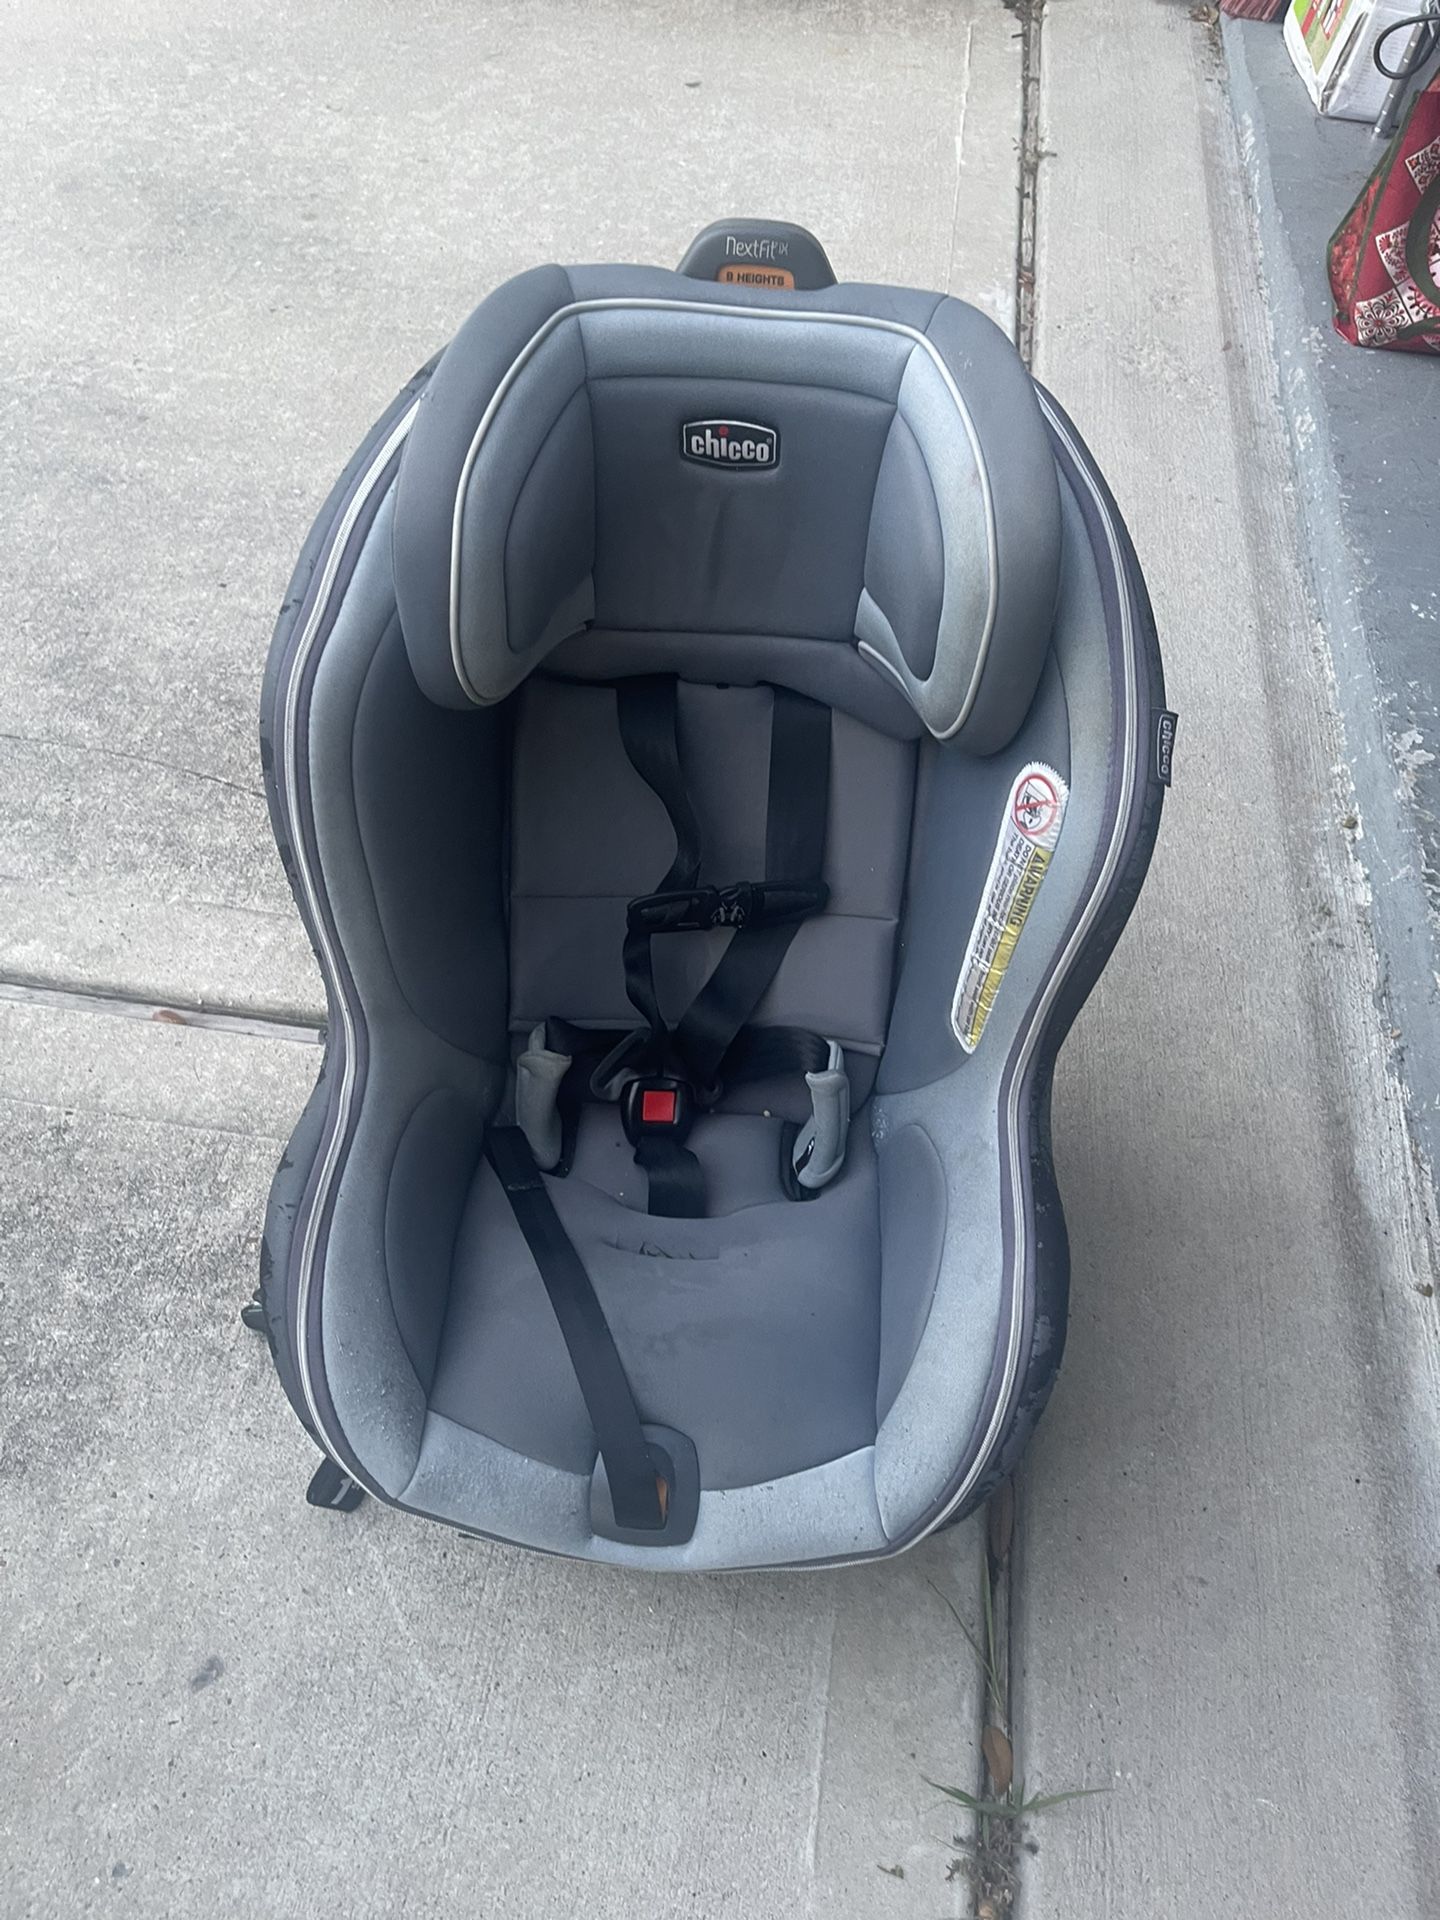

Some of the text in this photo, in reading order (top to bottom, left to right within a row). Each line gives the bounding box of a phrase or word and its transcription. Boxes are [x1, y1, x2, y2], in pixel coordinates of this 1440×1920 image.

[691, 425, 770, 462] chicco
[1161, 719, 1173, 774] chicco
[1009, 865, 1043, 927] WARNING
